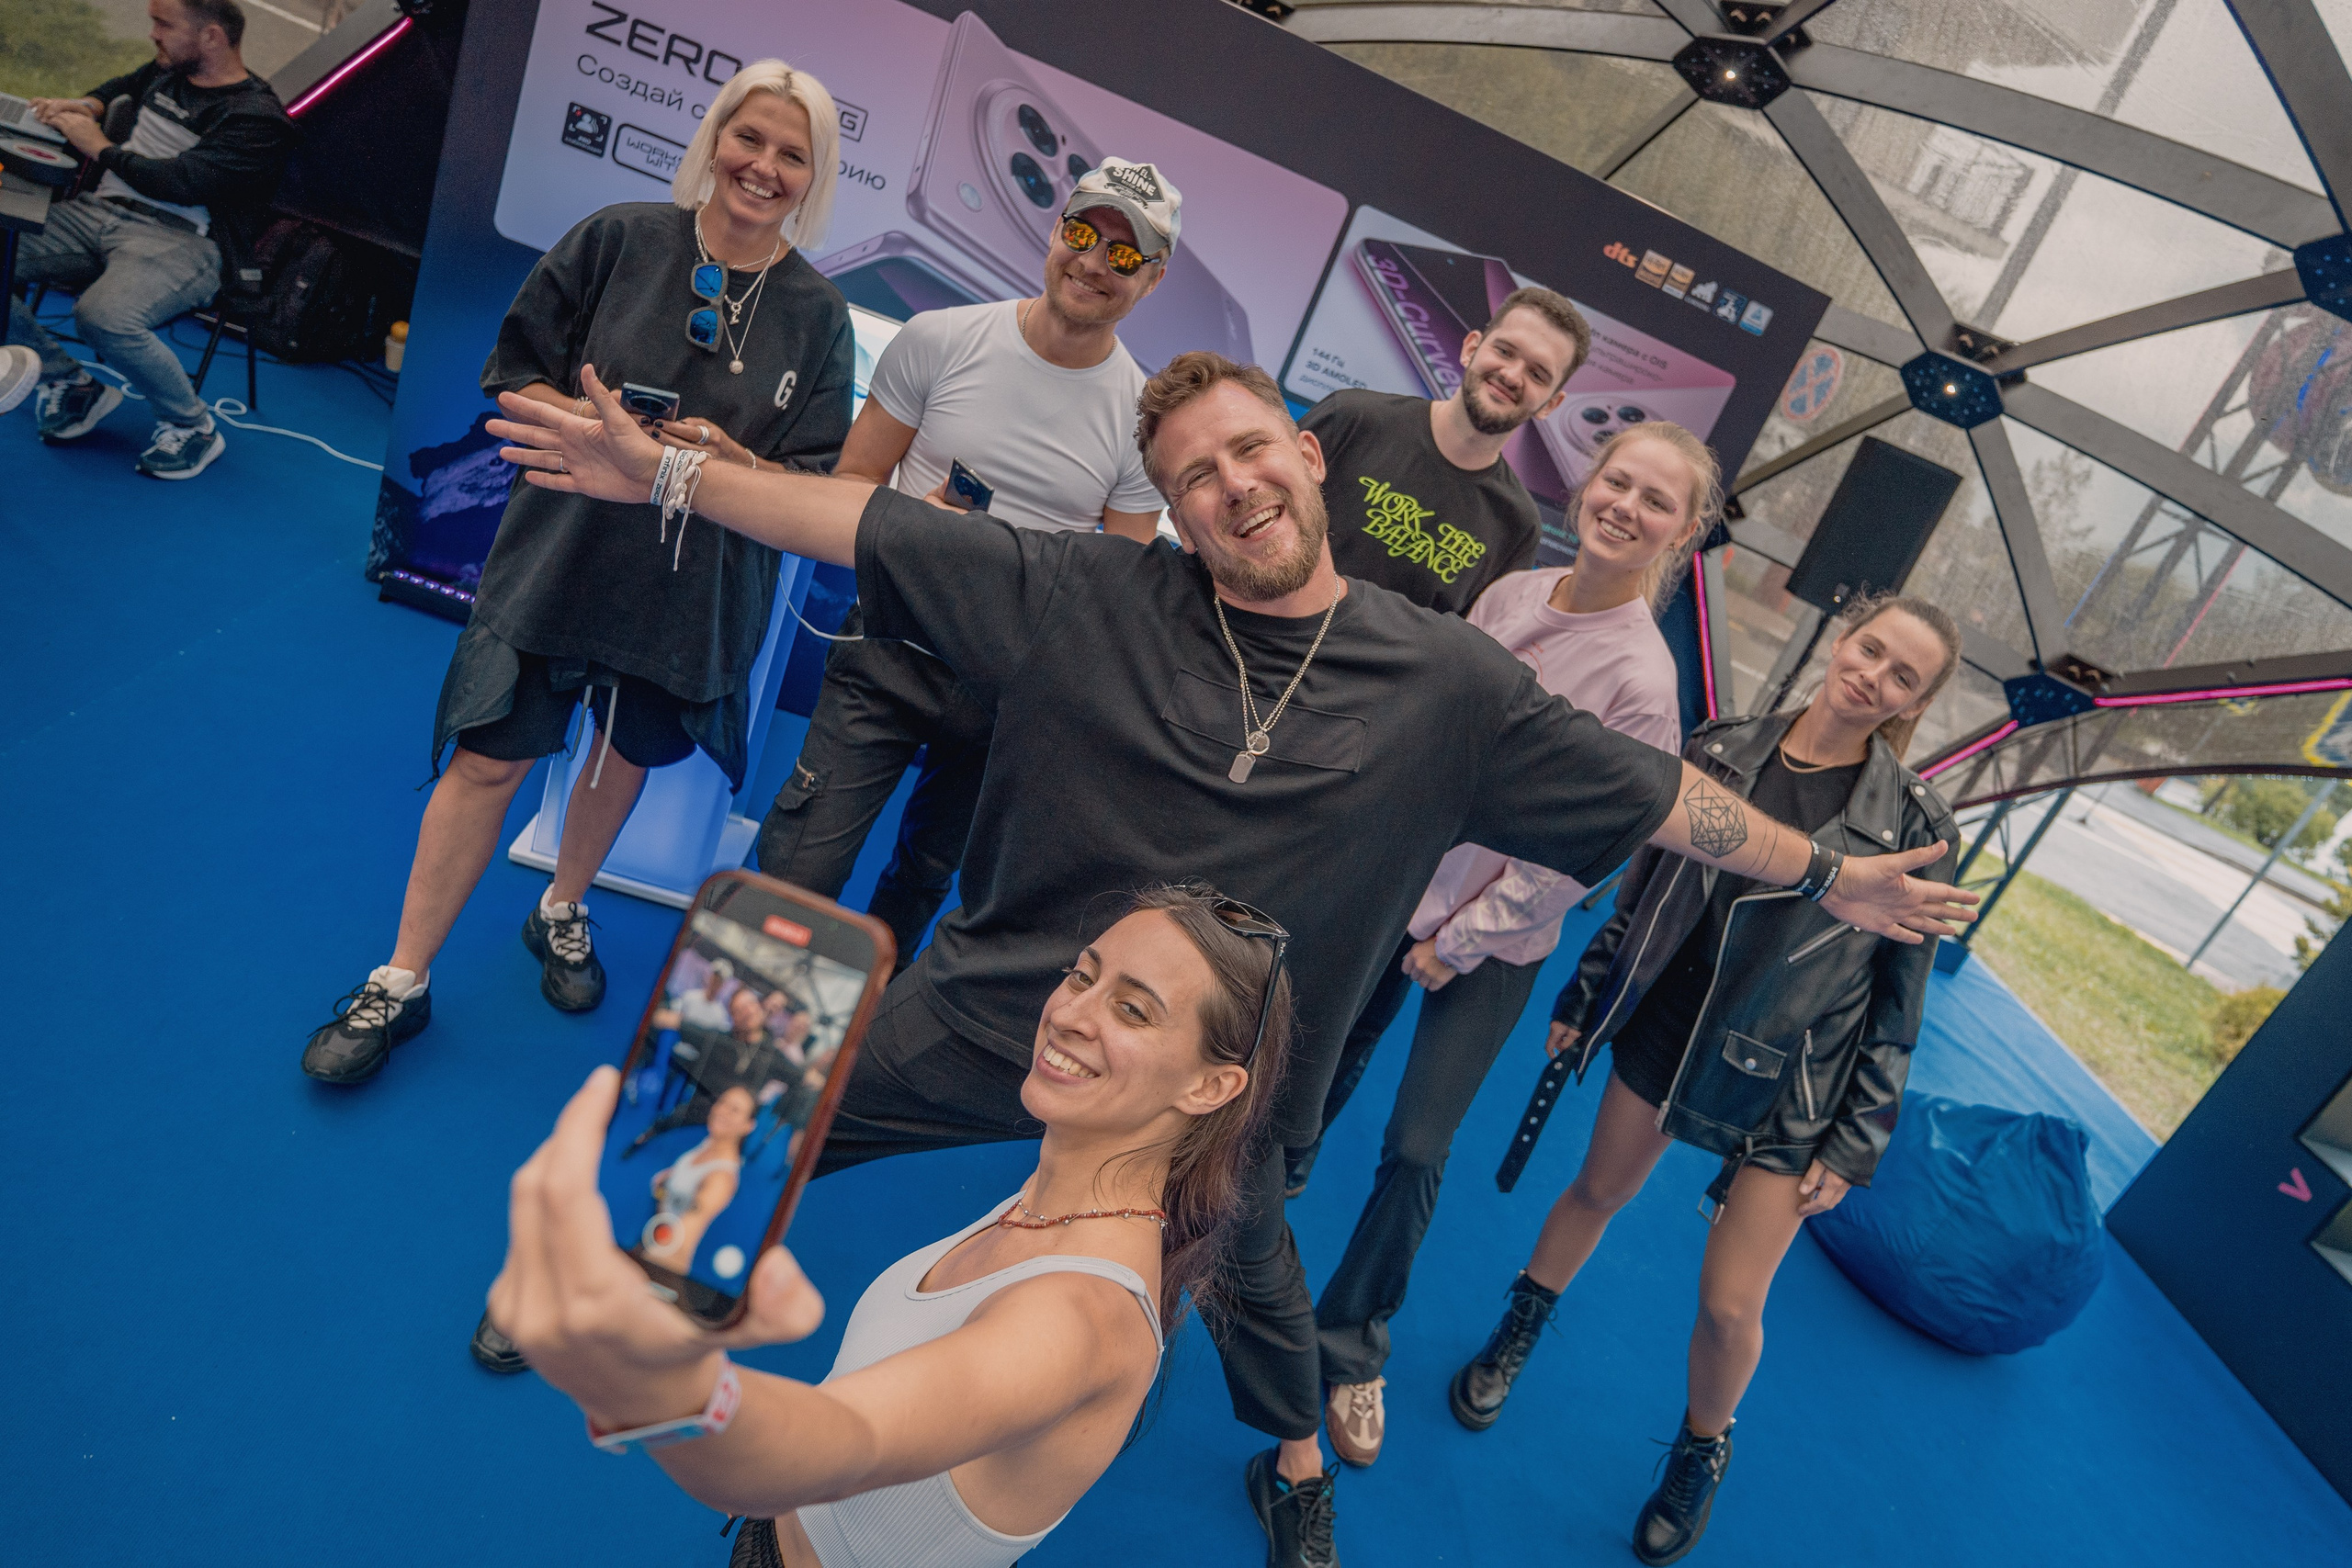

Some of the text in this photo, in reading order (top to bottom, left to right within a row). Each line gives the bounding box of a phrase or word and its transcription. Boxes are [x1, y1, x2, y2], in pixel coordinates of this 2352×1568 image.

[585, 1, 742, 86] ZERO
[577, 54, 684, 111] Создай
[1113, 166, 1157, 197] SHINE
[1603, 242, 1636, 268] dts
[1358, 476, 1435, 540] WORK
[1361, 507, 1464, 584] BALANCE
